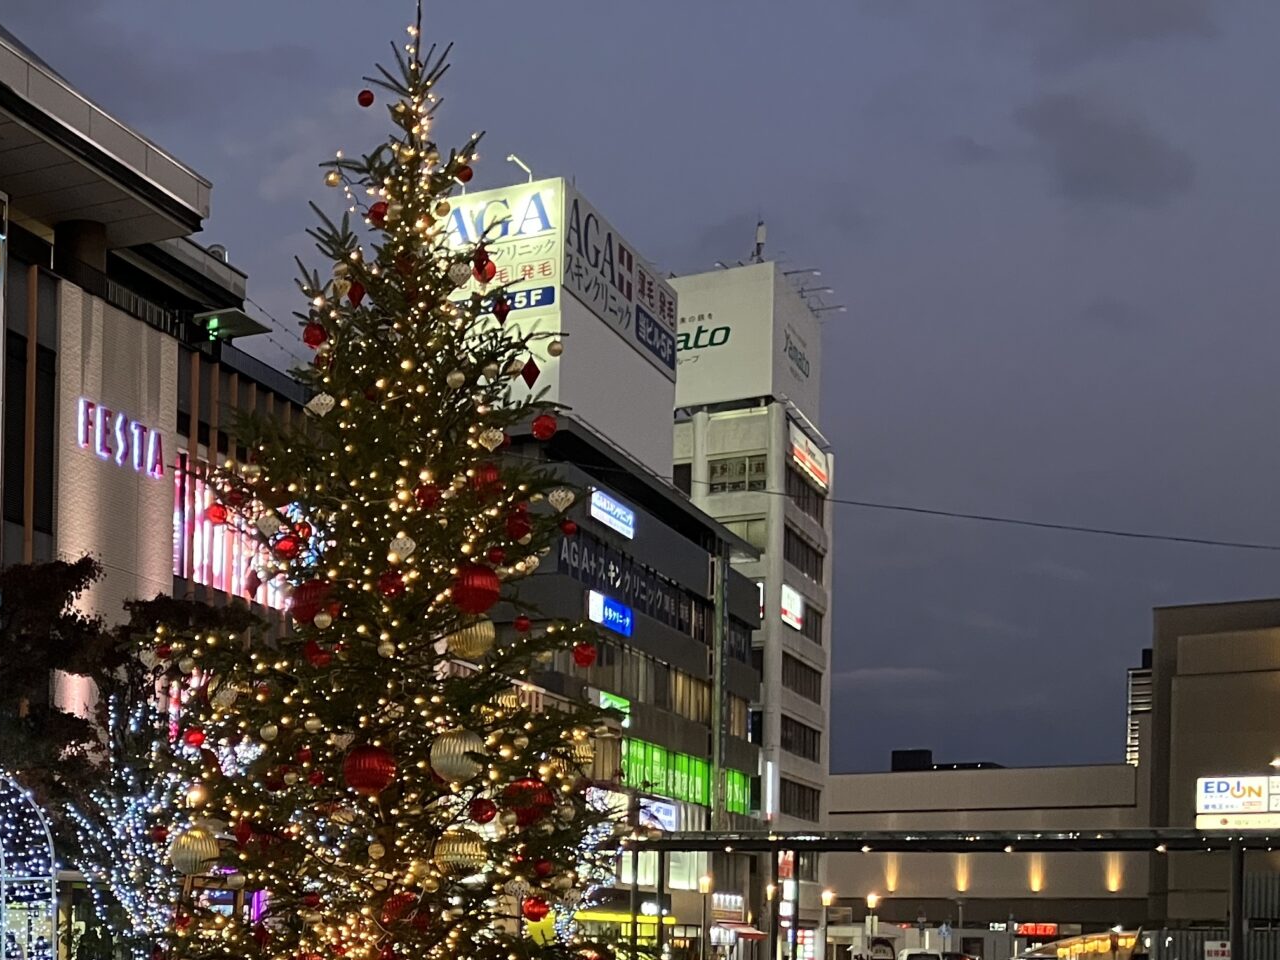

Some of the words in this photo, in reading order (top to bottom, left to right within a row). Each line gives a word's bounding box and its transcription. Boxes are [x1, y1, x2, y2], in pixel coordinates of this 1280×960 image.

[442, 191, 557, 247] AGA
[566, 198, 616, 288] AGA
[565, 252, 632, 331] スキンクリニック
[677, 325, 731, 352] ato
[77, 397, 165, 480] FESTA
[1203, 780, 1262, 799] EDION
